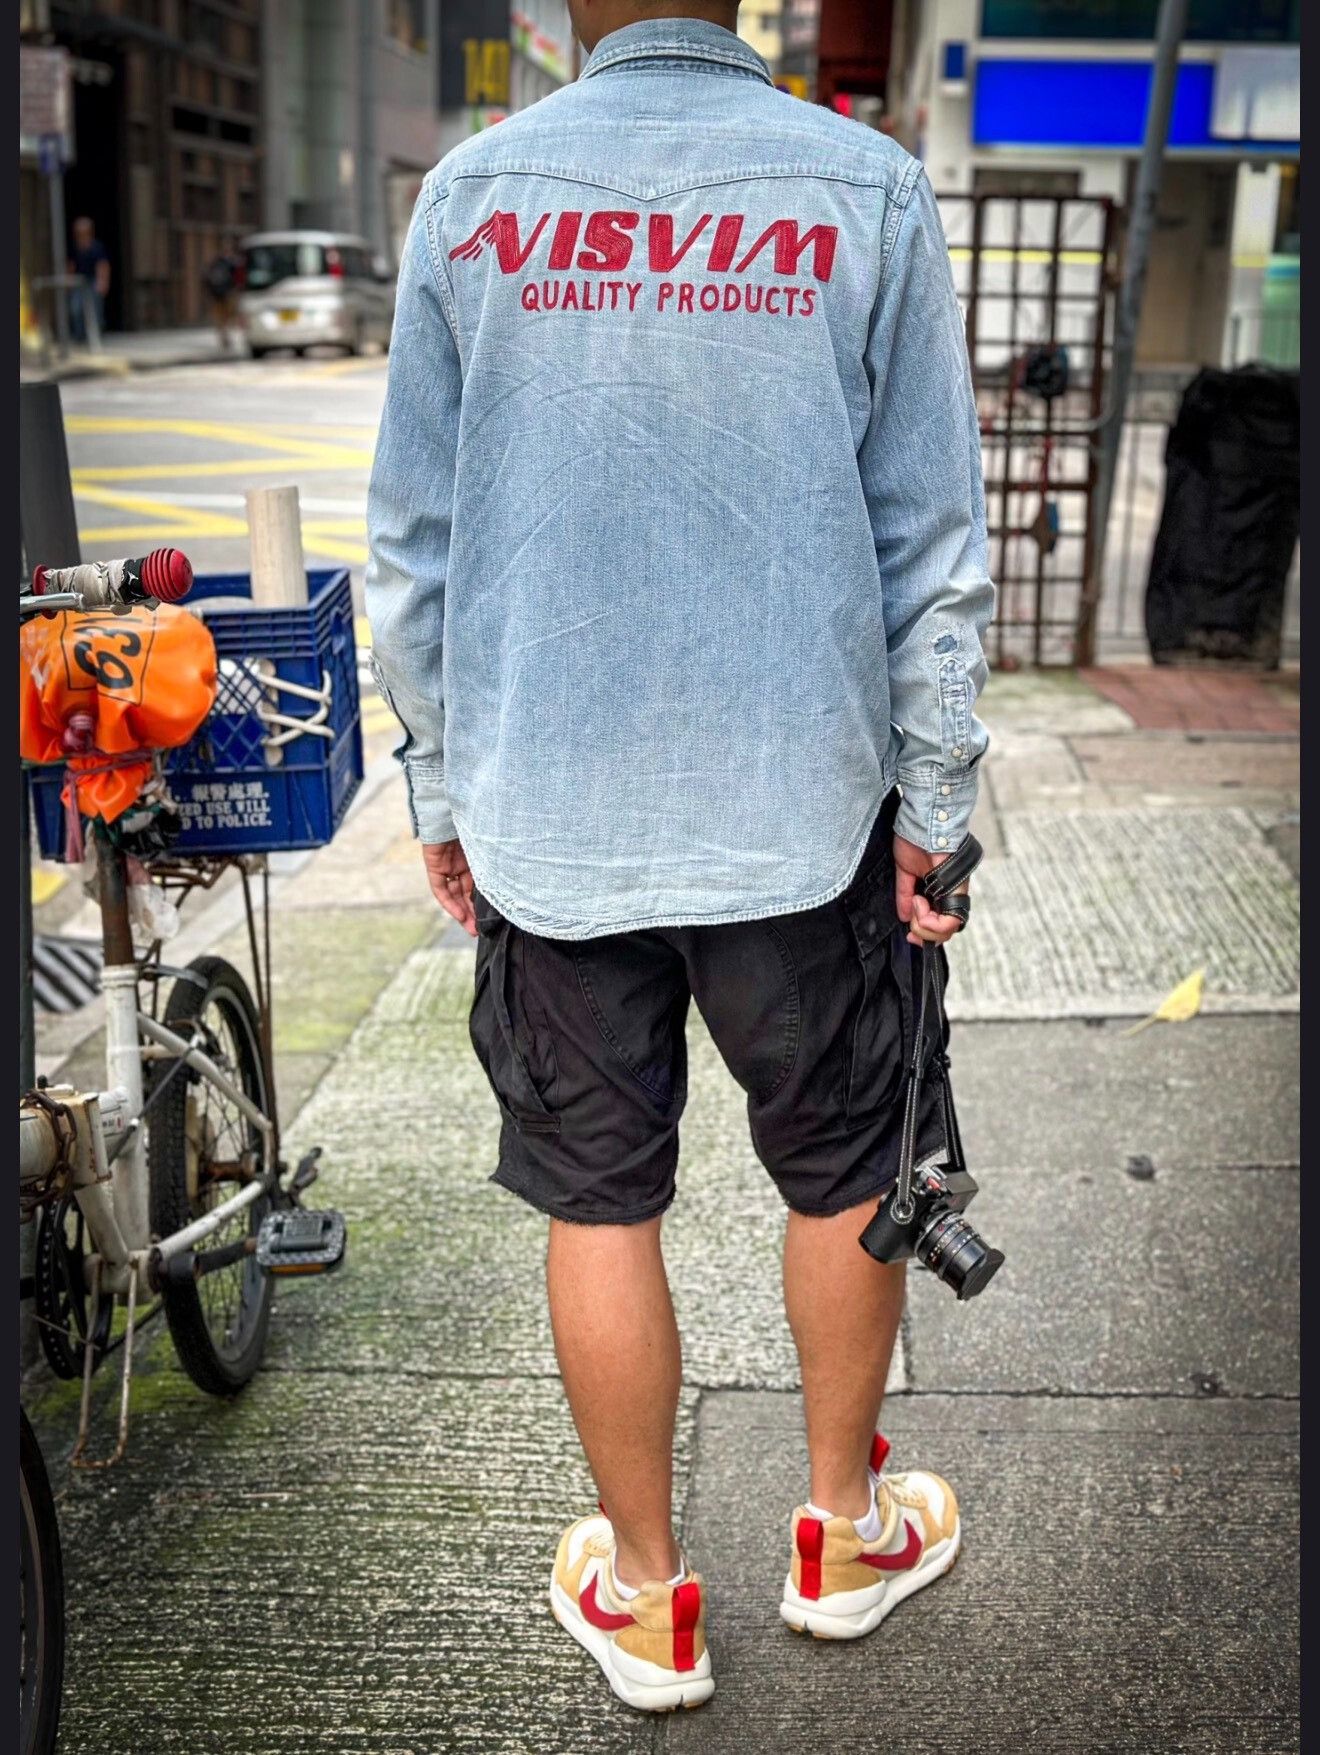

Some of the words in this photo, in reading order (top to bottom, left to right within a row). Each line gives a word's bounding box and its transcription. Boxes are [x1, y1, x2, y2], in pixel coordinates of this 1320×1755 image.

[449, 209, 838, 283] VISVIM
[521, 280, 643, 313] QUALITY
[657, 281, 817, 317] PRODUCTS
[195, 815, 214, 830] TO
[218, 812, 272, 829] POLICE.
[205, 801, 232, 815] USE
